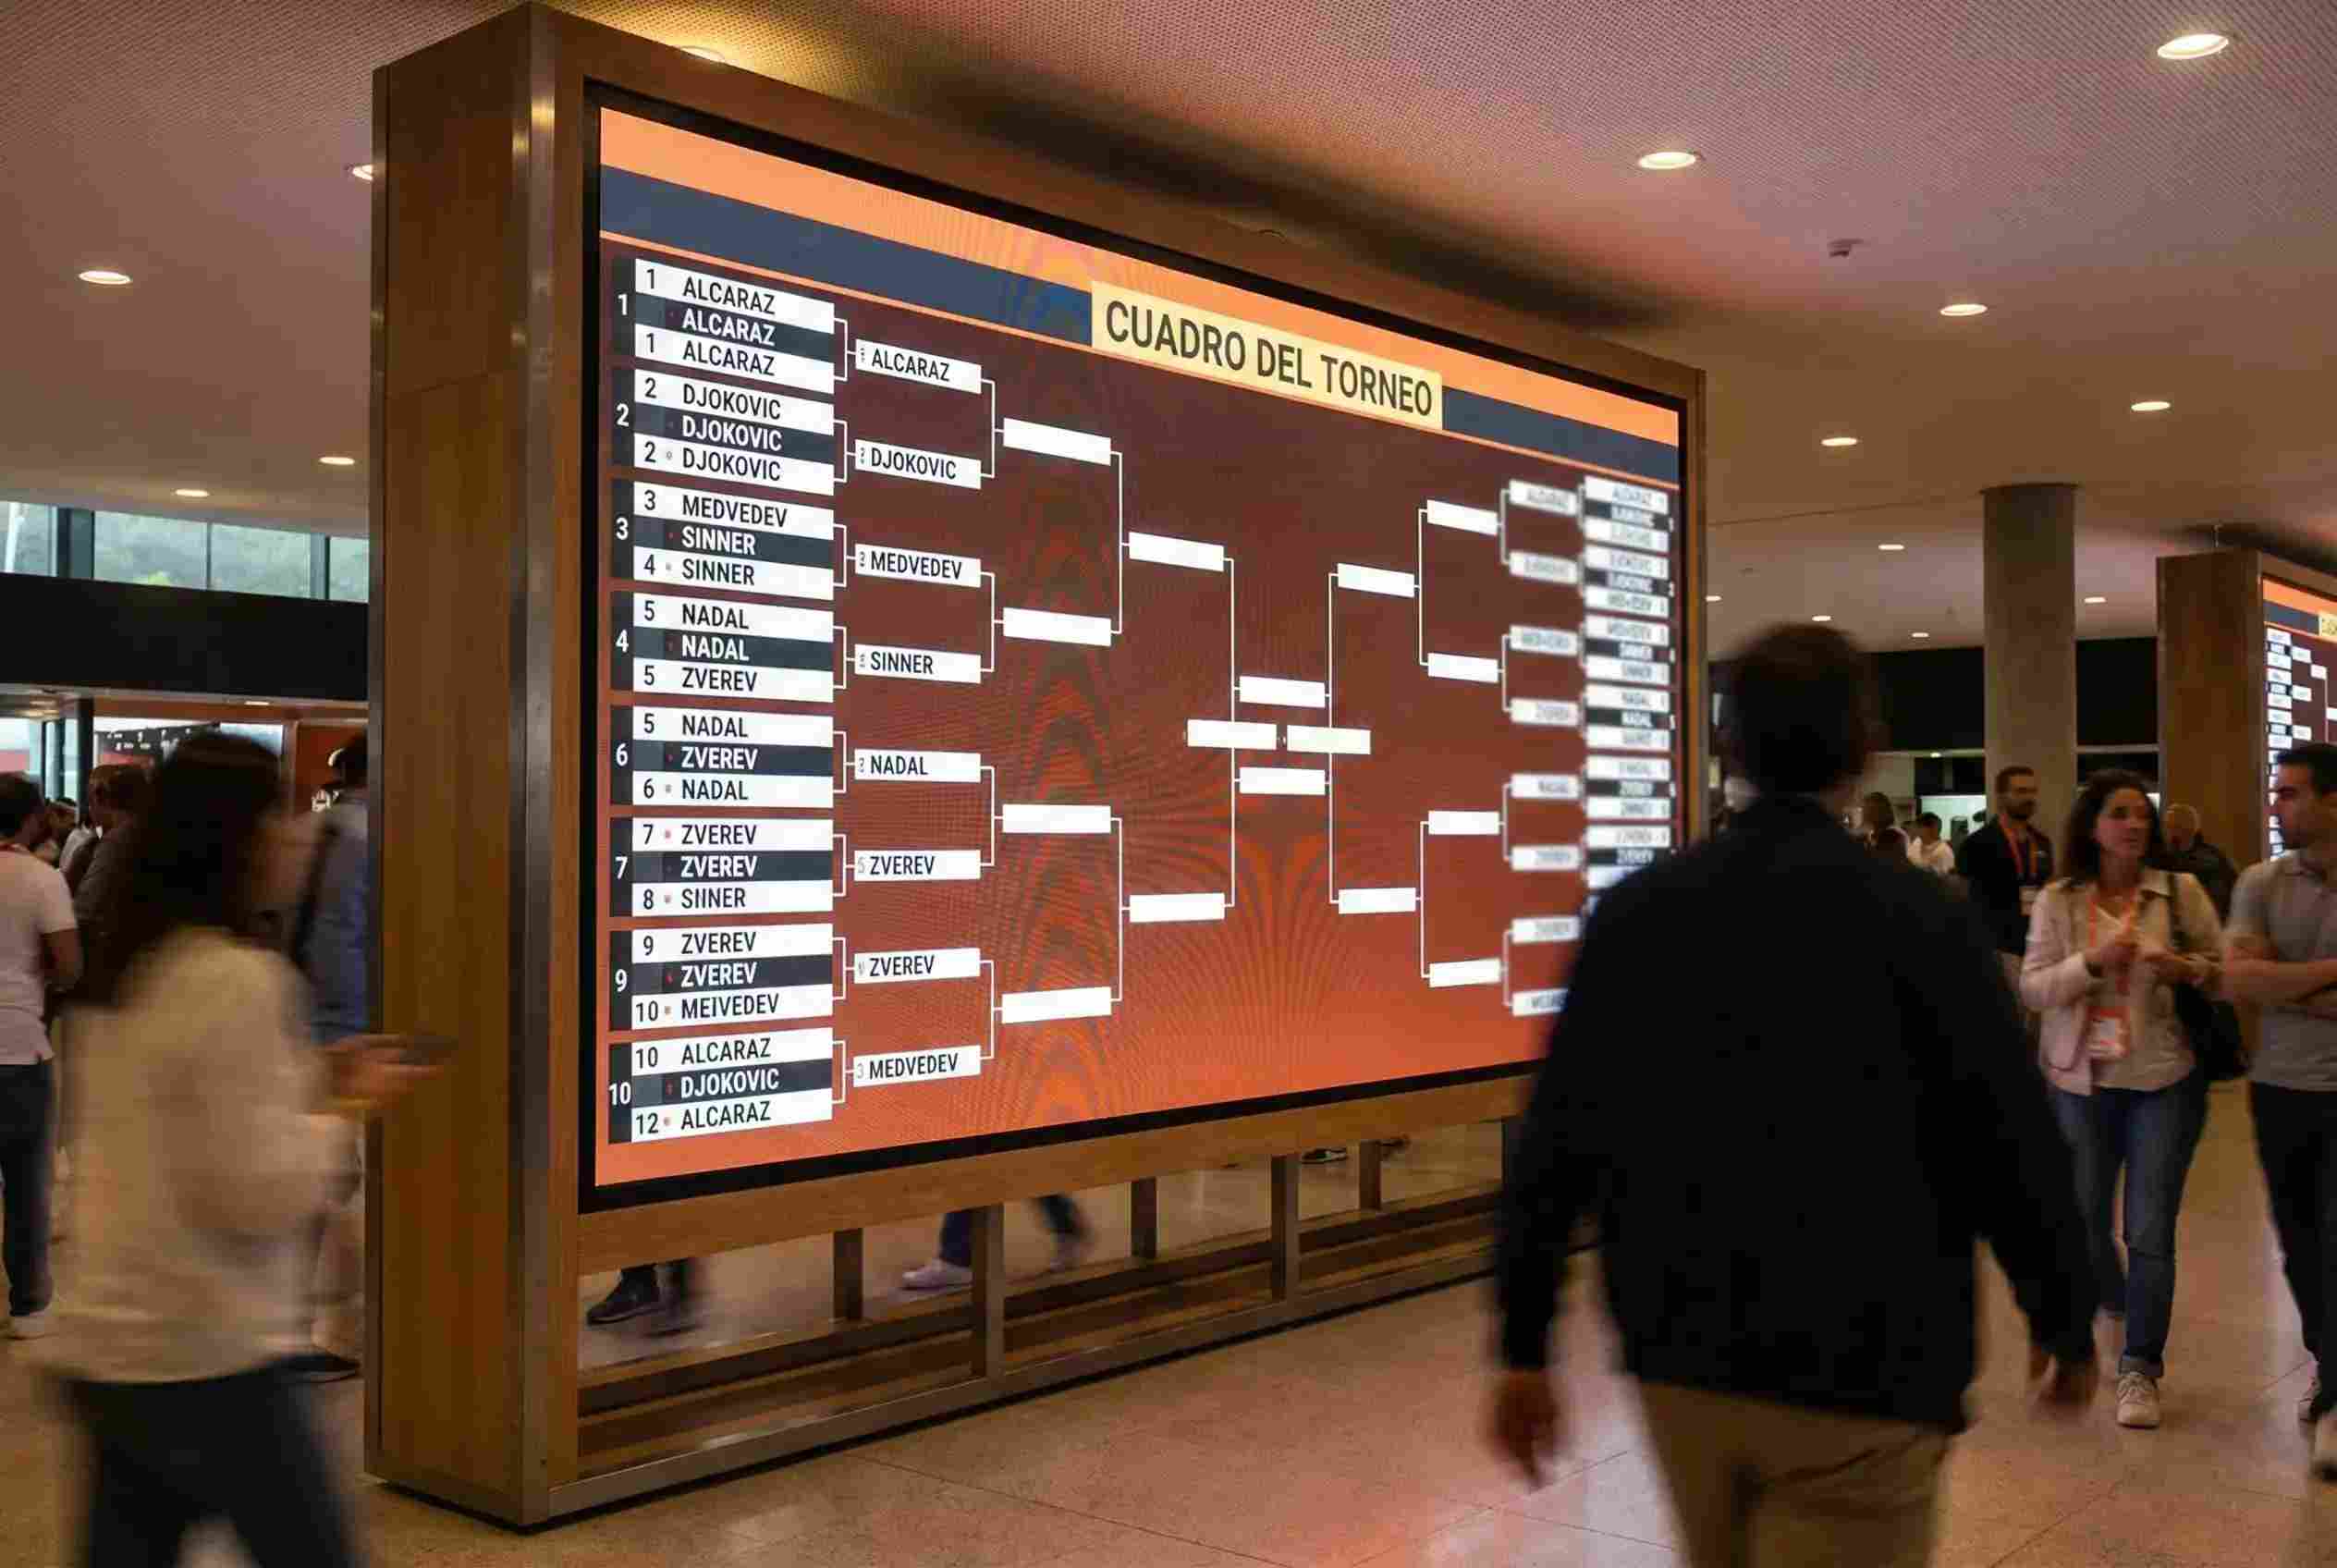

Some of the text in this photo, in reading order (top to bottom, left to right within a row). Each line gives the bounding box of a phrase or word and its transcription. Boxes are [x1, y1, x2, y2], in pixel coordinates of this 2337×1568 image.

[618, 293, 628, 316] 1
[646, 269, 776, 315] 1 ALCARAZ
[682, 309, 776, 346] ALCARAZ
[646, 334, 776, 375] 1 ALCARAZ
[872, 348, 949, 382] ALCARAZ
[1106, 300, 1432, 416] CUADRO DEL TORNEO
[644, 378, 781, 420] 2 DJOKOVIC
[617, 404, 629, 426] 2
[682, 416, 782, 450] DJOKOVIC
[644, 442, 781, 482] 2 DJOKOVIC
[871, 447, 957, 479] DJOKOVIC
[644, 491, 788, 527] 3 MEDVEDEV
[617, 518, 628, 540] 3
[682, 525, 756, 555] SINNER
[643, 556, 754, 585] 4 SINNER
[871, 553, 961, 579] MEDVEDEV
[644, 601, 749, 630] 5 NADAL
[616, 630, 629, 652] 4
[682, 636, 749, 662] NADAL
[871, 655, 933, 674] SINNER
[644, 667, 757, 692] 5 ZVEREV
[643, 714, 748, 737] 5 NADAL
[617, 743, 628, 766] 6
[681, 747, 757, 770] ZVEREV
[870, 756, 928, 775] NADAL
[643, 779, 748, 800] 6 NADAL
[643, 825, 757, 845] 7 ZVEREV
[616, 857, 628, 879] 7
[681, 856, 757, 877] ZVEREV
[870, 857, 935, 875] ZVEREV
[643, 889, 654, 909] 8
[643, 932, 756, 956] 9 ZVEREV
[681, 962, 757, 987] ZVEREV
[869, 956, 935, 976] ZVEREV
[616, 969, 627, 992] 9
[636, 1001, 658, 1022] 10
[636, 1038, 771, 1067] 10 ALCARAZ
[869, 1054, 958, 1080] MEDVEDEV
[609, 1083, 630, 1106] 10
[681, 1069, 779, 1098] DJOKOVIC
[636, 1101, 771, 1133] 12 ALCARAZ
